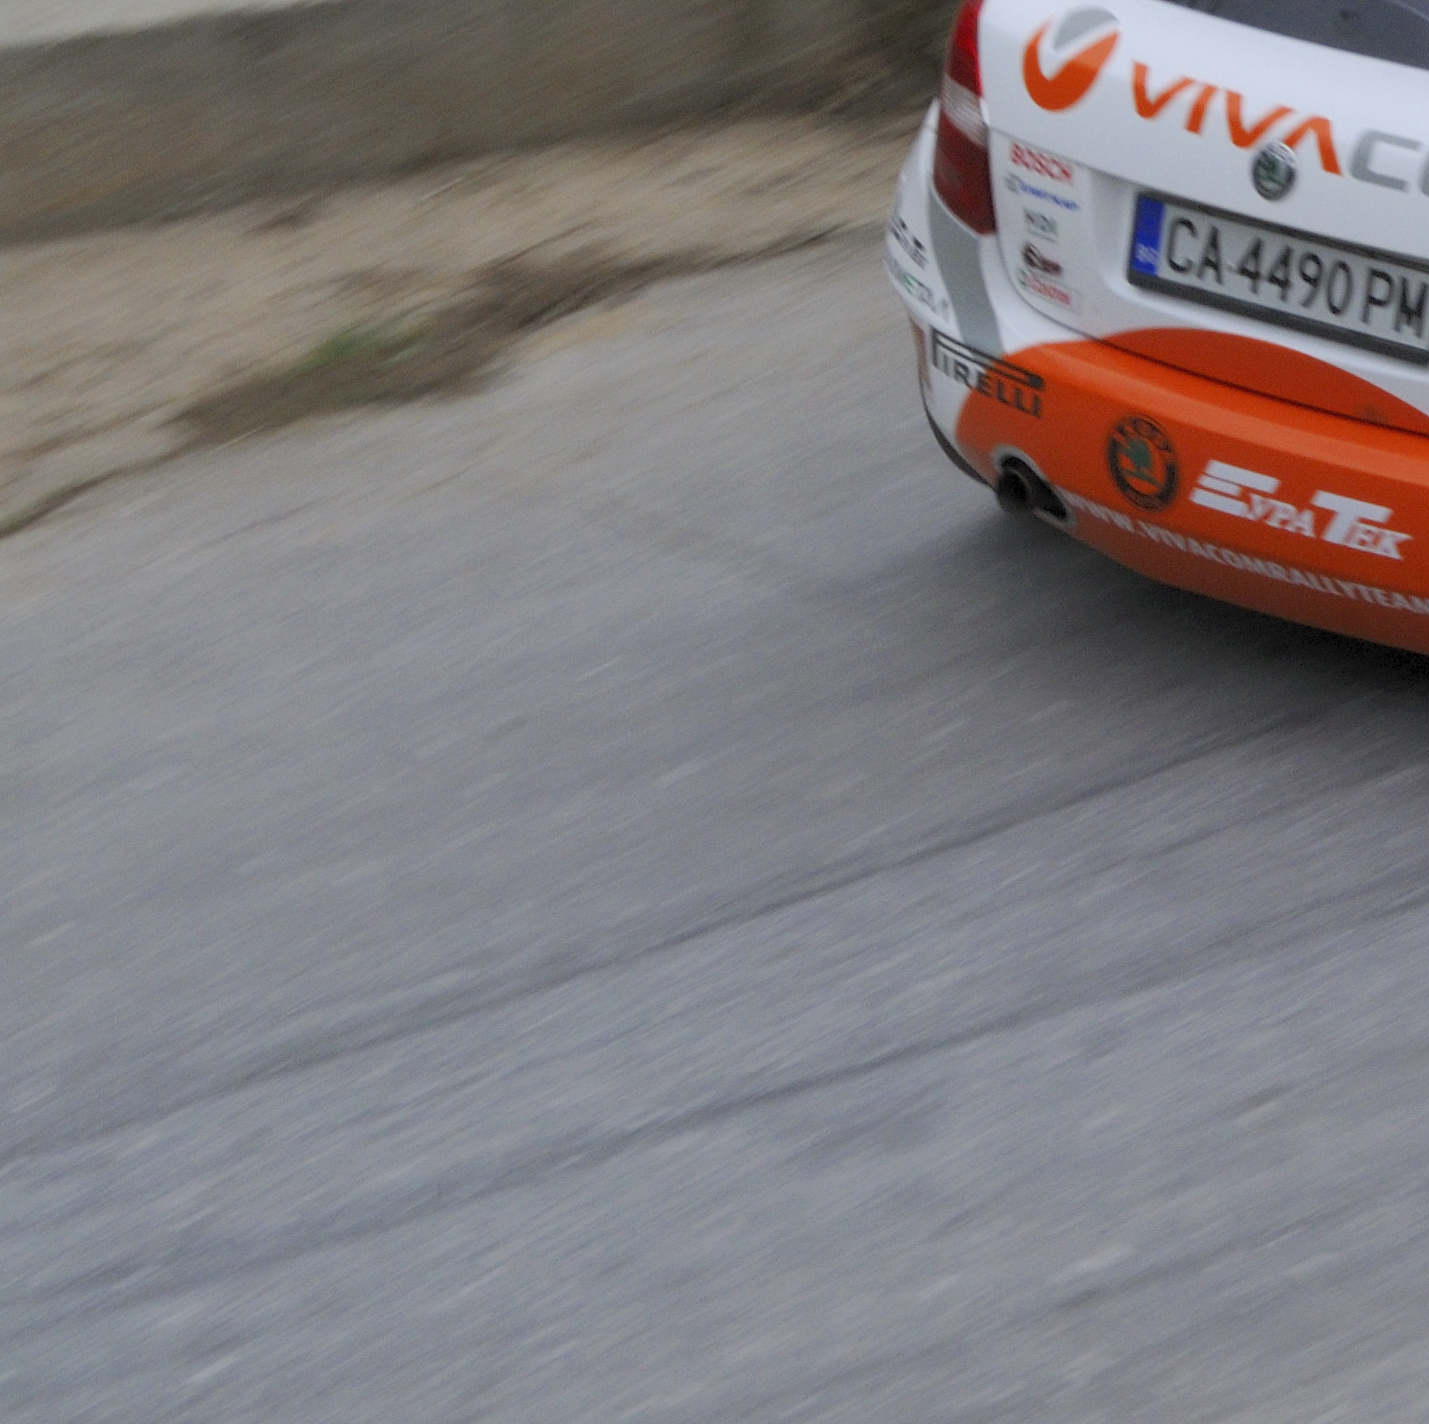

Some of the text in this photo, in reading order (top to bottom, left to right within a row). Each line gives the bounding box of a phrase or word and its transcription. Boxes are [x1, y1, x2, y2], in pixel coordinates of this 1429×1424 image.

[1010, 141, 1074, 188] BOSCH
[1167, 217, 1224, 285] CA
[1237, 236, 1353, 317] 4490
[1362, 267, 1429, 339] PM
[931, 326, 1046, 418] PIRELLI
